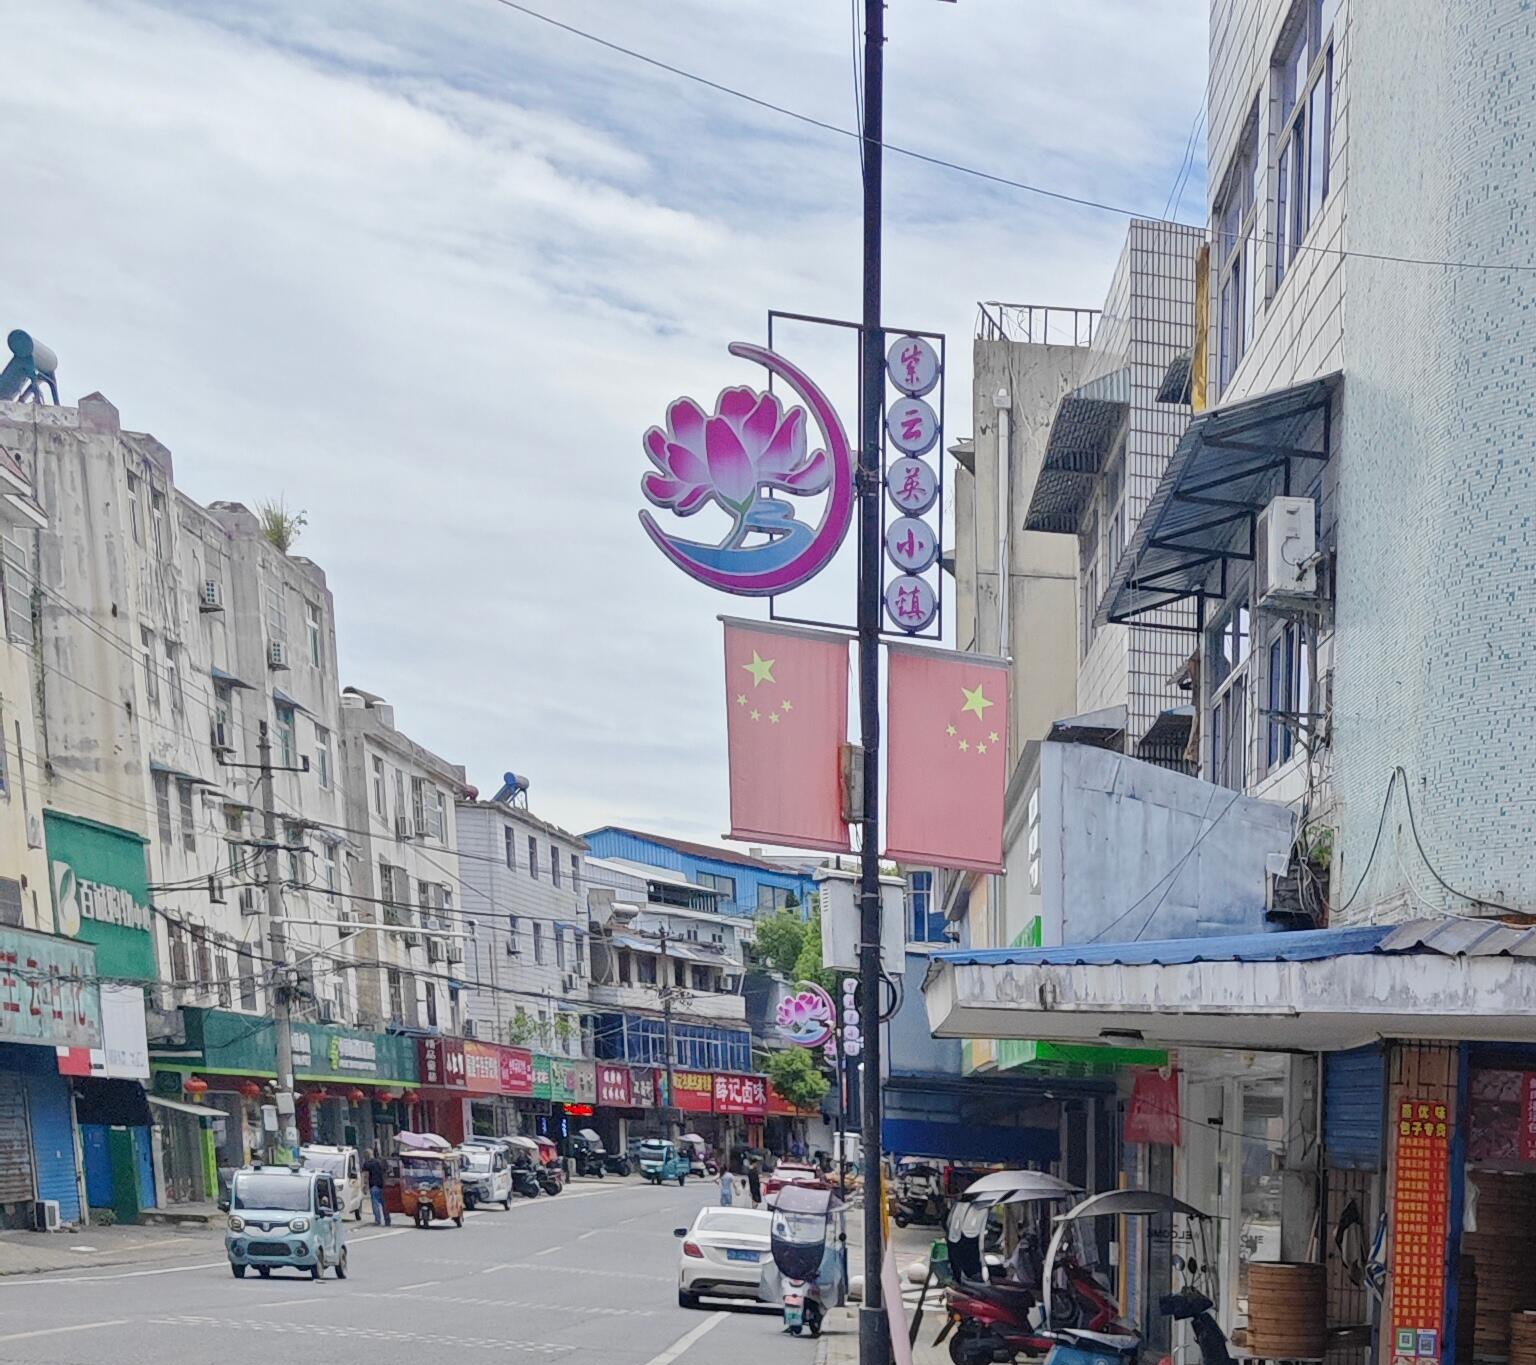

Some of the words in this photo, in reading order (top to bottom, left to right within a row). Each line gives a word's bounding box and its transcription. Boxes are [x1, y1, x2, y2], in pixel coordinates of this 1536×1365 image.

[896, 346, 925, 620] 紫云英小镇
